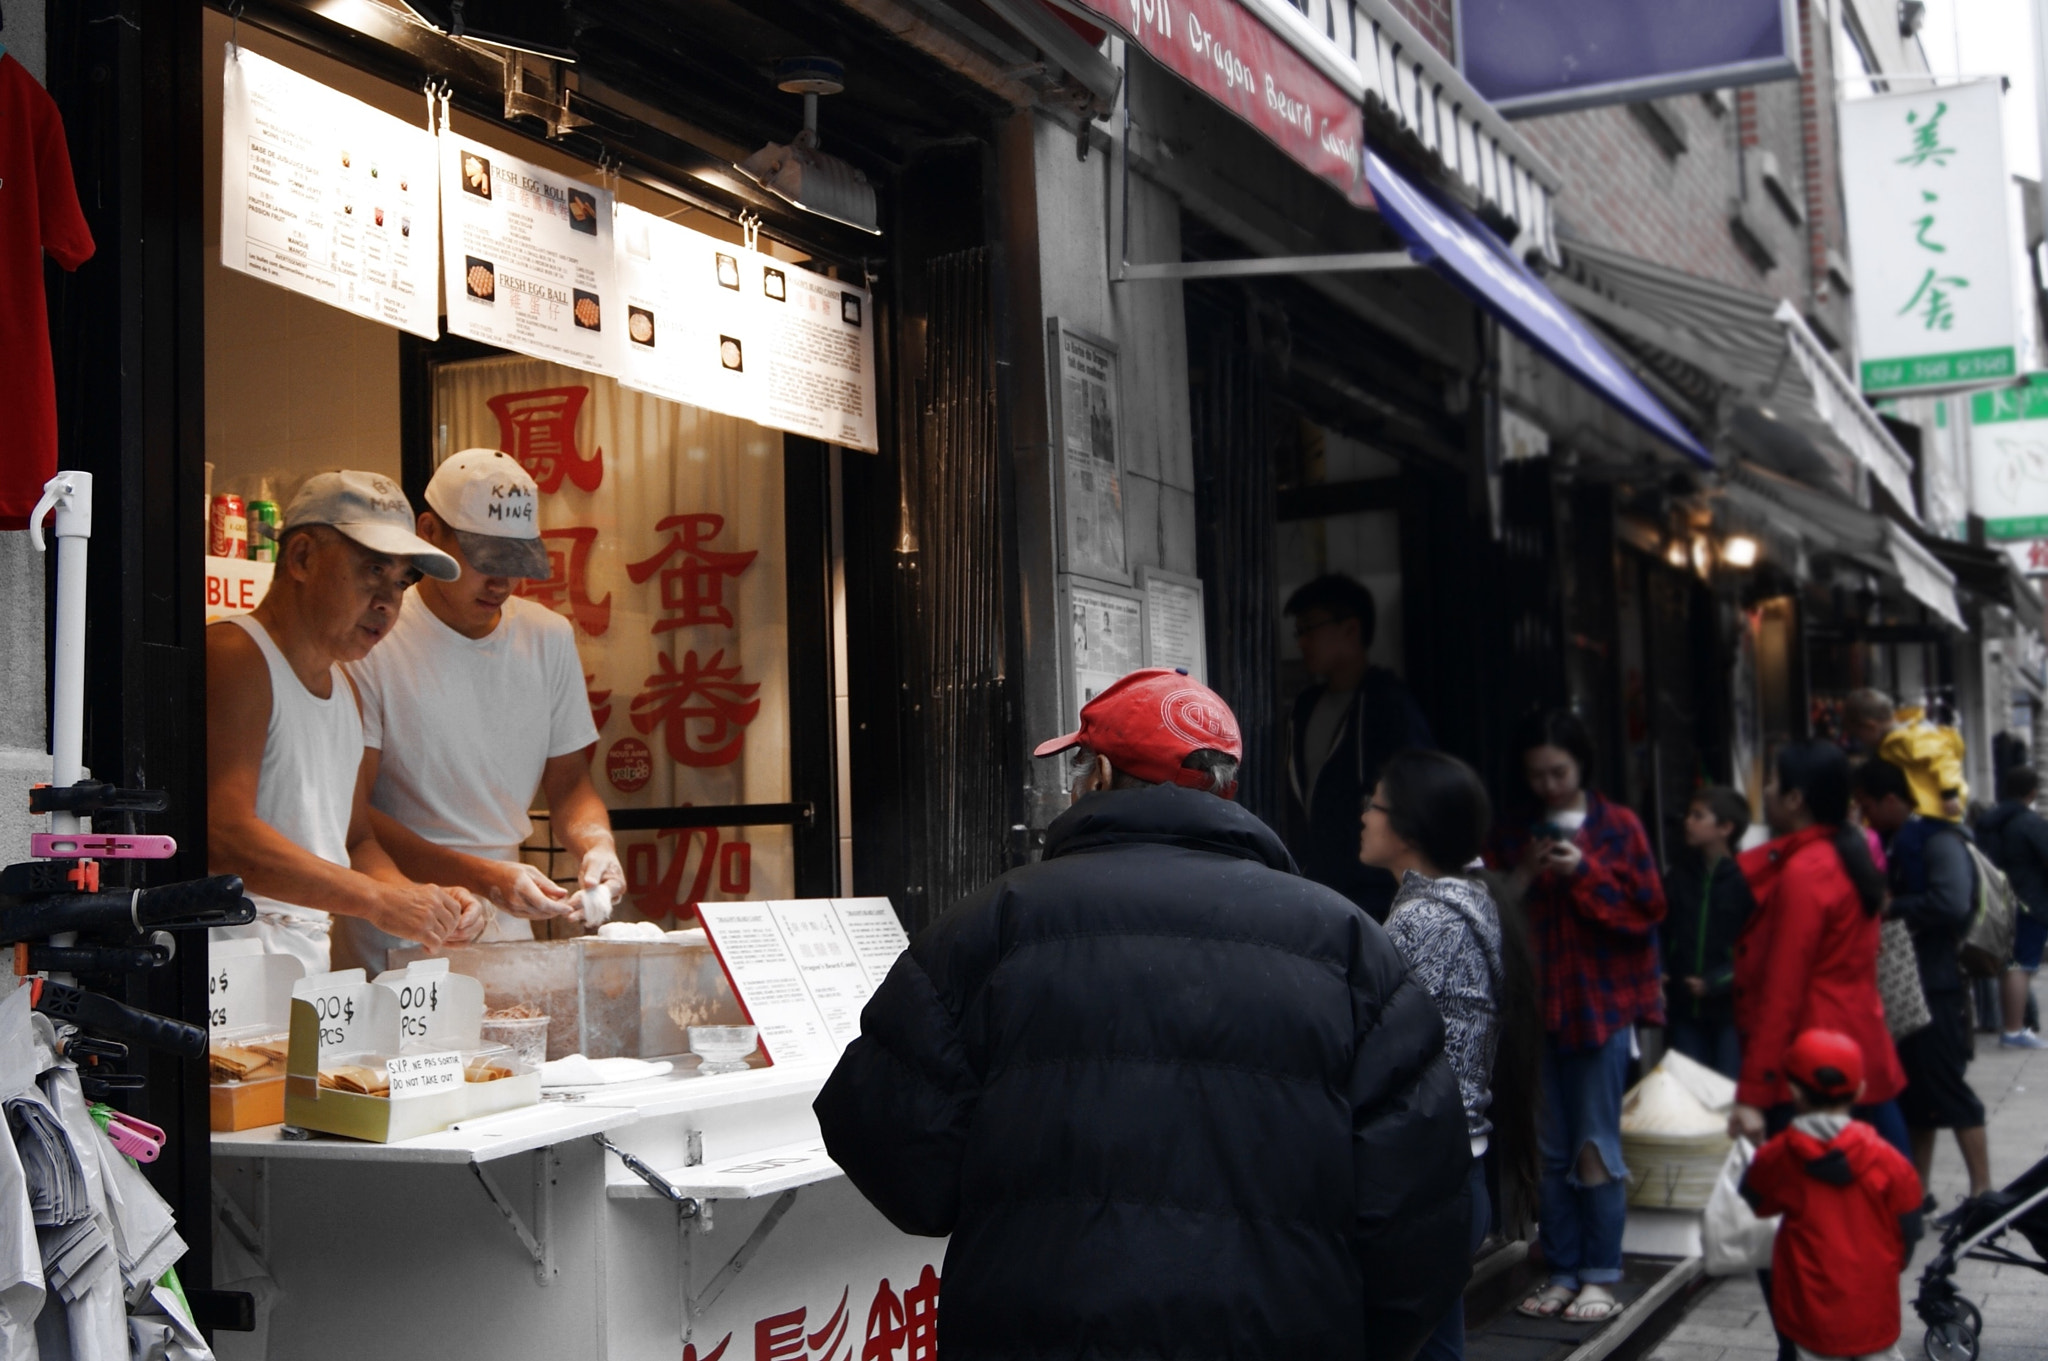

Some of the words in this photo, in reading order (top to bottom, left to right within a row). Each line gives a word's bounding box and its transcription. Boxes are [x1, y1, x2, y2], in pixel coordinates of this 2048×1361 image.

[1188, 11, 1255, 94] Dragon
[1264, 72, 1312, 139] Beard
[490, 164, 518, 185] FRESH
[521, 176, 541, 193] EGG
[543, 184, 567, 202] ROLL
[1895, 102, 1970, 332] 美之舍
[499, 272, 526, 291] FRESH
[527, 281, 545, 298] EGG
[547, 287, 569, 305] BALL
[488, 502, 532, 522] MING
[206, 575, 255, 609] BLE
[611, 765, 638, 782] yelp
[316, 995, 354, 1026] 00$
[400, 981, 438, 1012] 00$
[319, 1027, 345, 1048] PCS
[402, 1016, 427, 1038] PCS
[412, 1060, 422, 1070] NE
[424, 1058, 437, 1068] PAS
[437, 1055, 460, 1066] SORTIR
[393, 1078, 404, 1090] DO
[405, 1077, 419, 1088] NOT
[421, 1075, 439, 1086] TAKE
[440, 1073, 453, 1083] OUT
